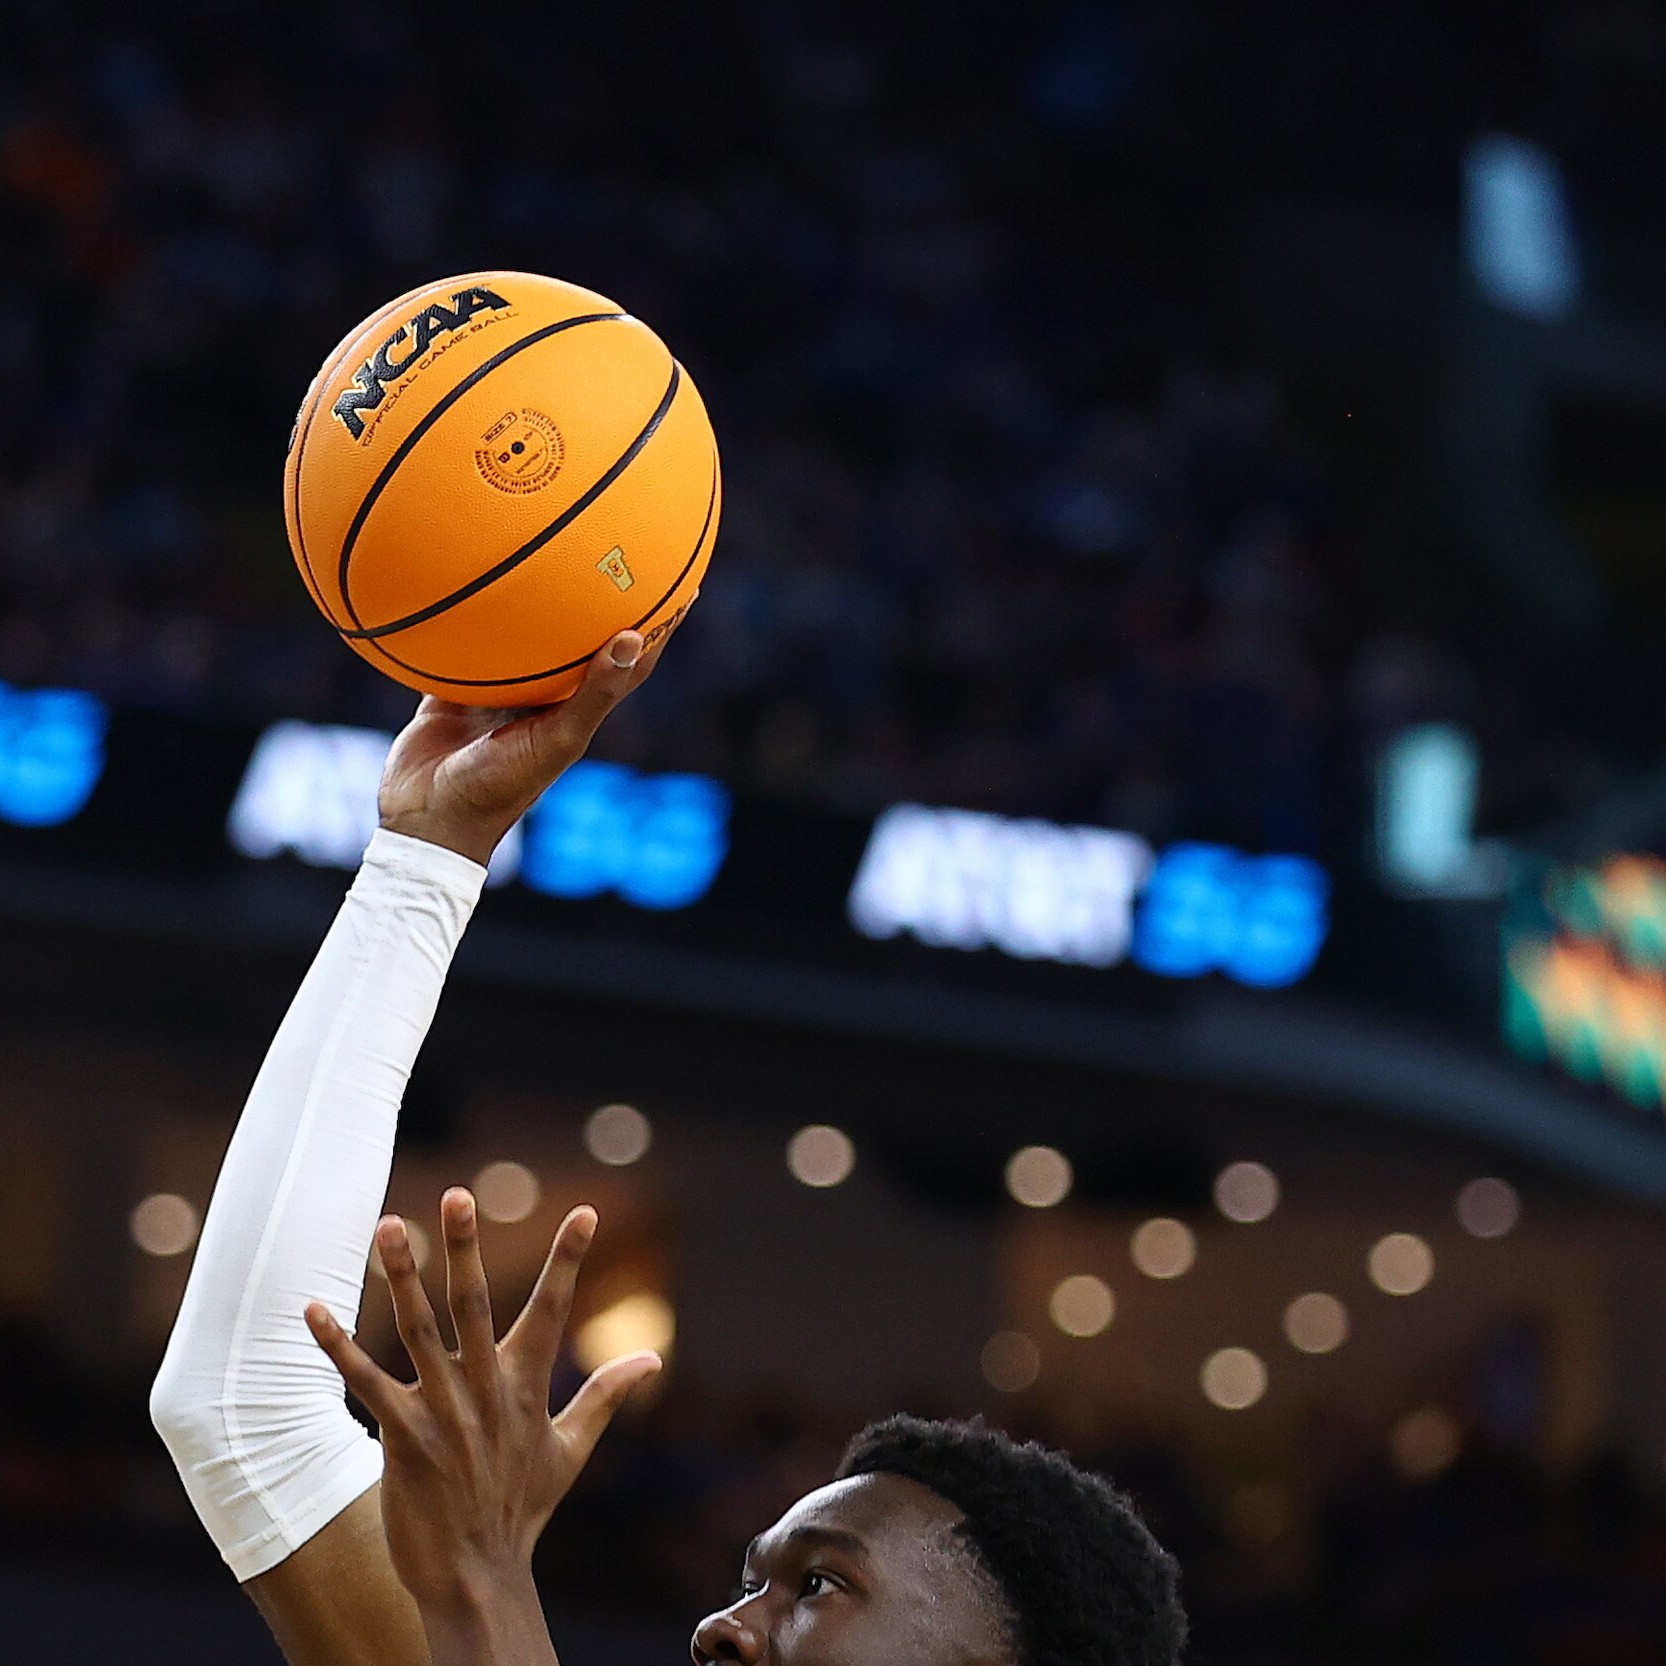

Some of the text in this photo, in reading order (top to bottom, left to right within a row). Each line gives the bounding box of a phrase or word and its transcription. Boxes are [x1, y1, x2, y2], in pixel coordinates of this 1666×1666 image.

[331, 285, 512, 440] NCAA
[420, 331, 469, 370] GAME
[471, 311, 520, 334] BALL
[851, 806, 1151, 962] AT&T
